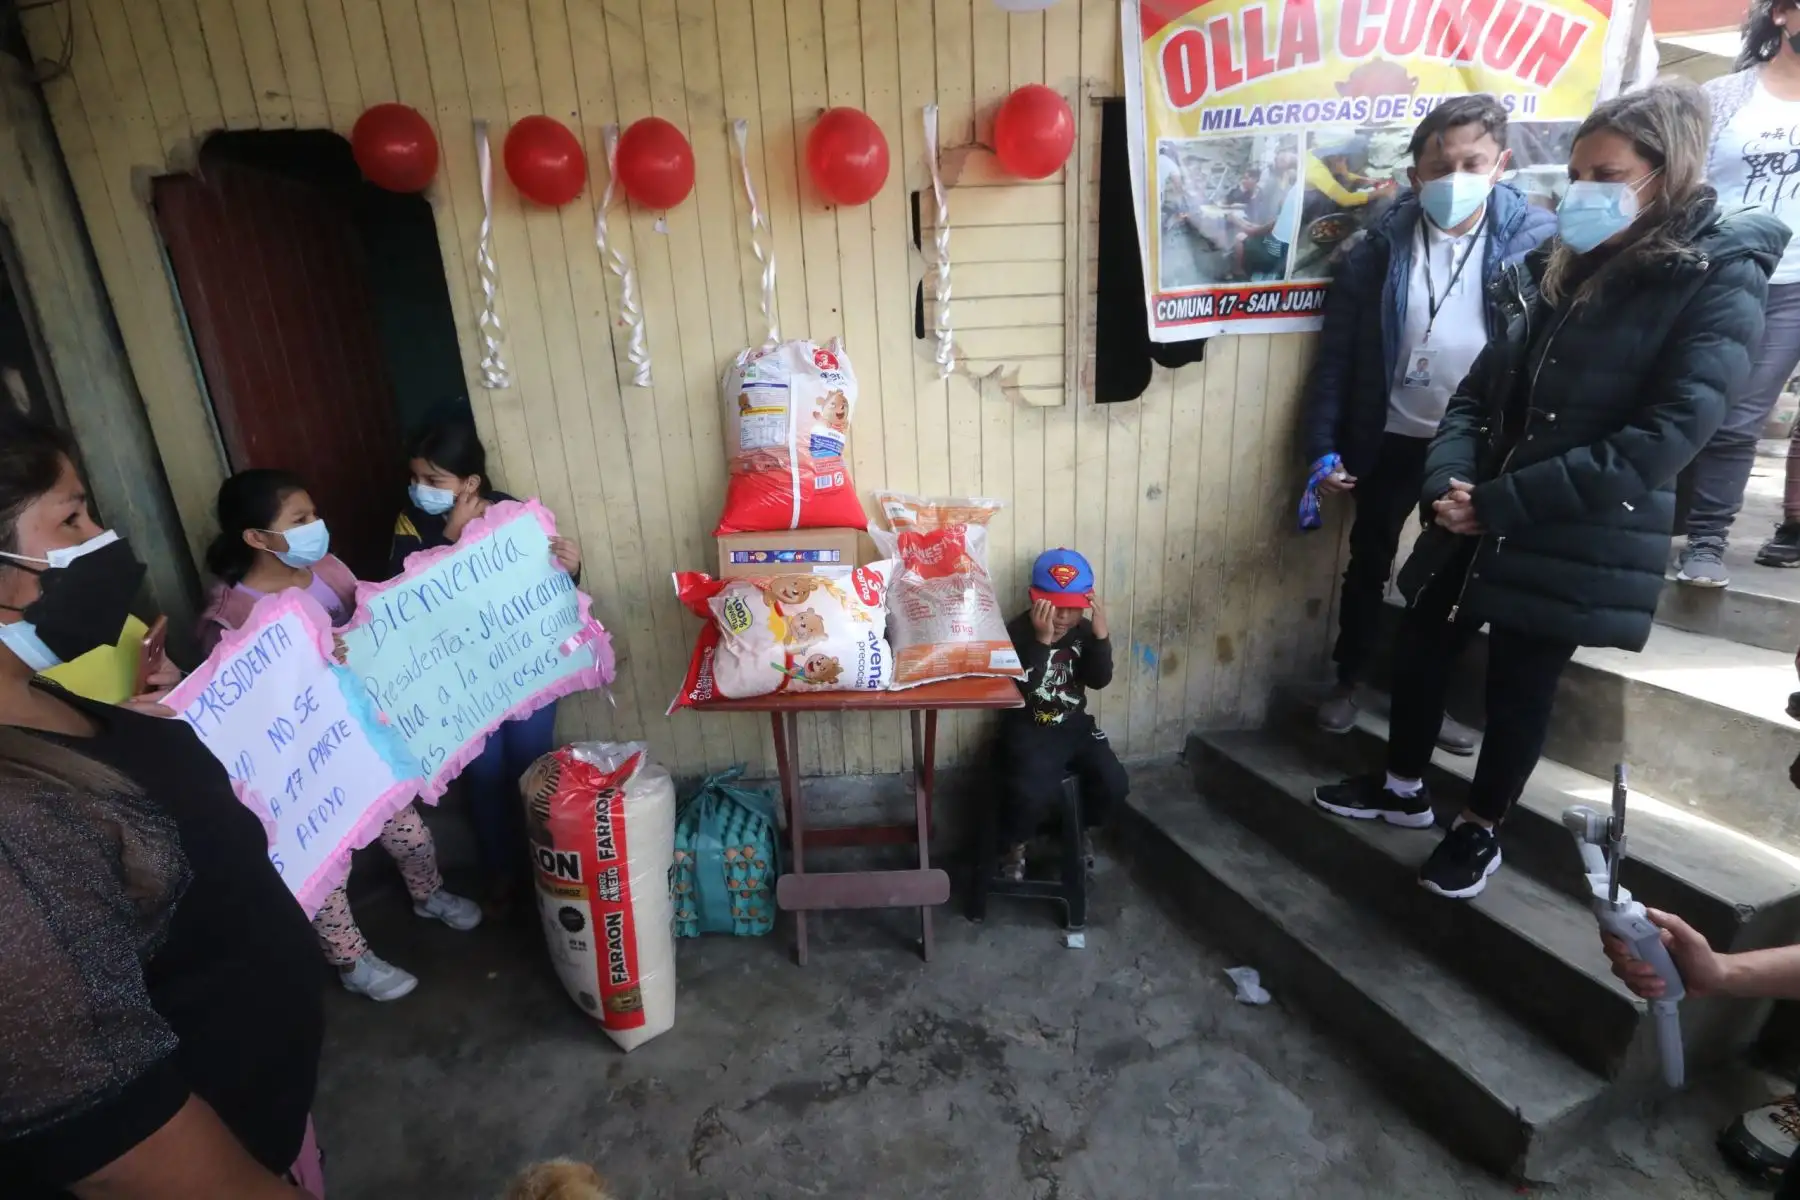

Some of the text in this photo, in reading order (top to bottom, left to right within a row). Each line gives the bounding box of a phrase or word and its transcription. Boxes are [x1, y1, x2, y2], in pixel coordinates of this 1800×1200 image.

[1162, 0, 1588, 108] OLLA COMUN
[1201, 99, 1367, 131] MILAGROSAS
[1375, 96, 1408, 119] DE
[1157, 295, 1213, 321] COMUNA
[1219, 295, 1238, 315] 17
[1246, 291, 1281, 313] SAN
[1283, 289, 1327, 311] JUAN
[363, 530, 529, 658] Bienvenida
[856, 568, 871, 601] OSITOS
[868, 579, 882, 592] 3
[727, 604, 739, 630] avena
[732, 598, 747, 629] 100%
[184, 622, 293, 737] PRESIDENTA
[438, 685, 451, 705] a
[455, 662, 479, 690] la
[856, 641, 866, 689] precocida
[867, 630, 882, 689] avena
[266, 716, 296, 754] NO
[293, 685, 320, 724] SE
[285, 767, 305, 803] 17
[307, 719, 352, 774] PARTE
[296, 786, 346, 850] APOYO
[595, 788, 616, 860] FARAON
[599, 871, 608, 901] ARROZ
[604, 911, 629, 985] FARAON
